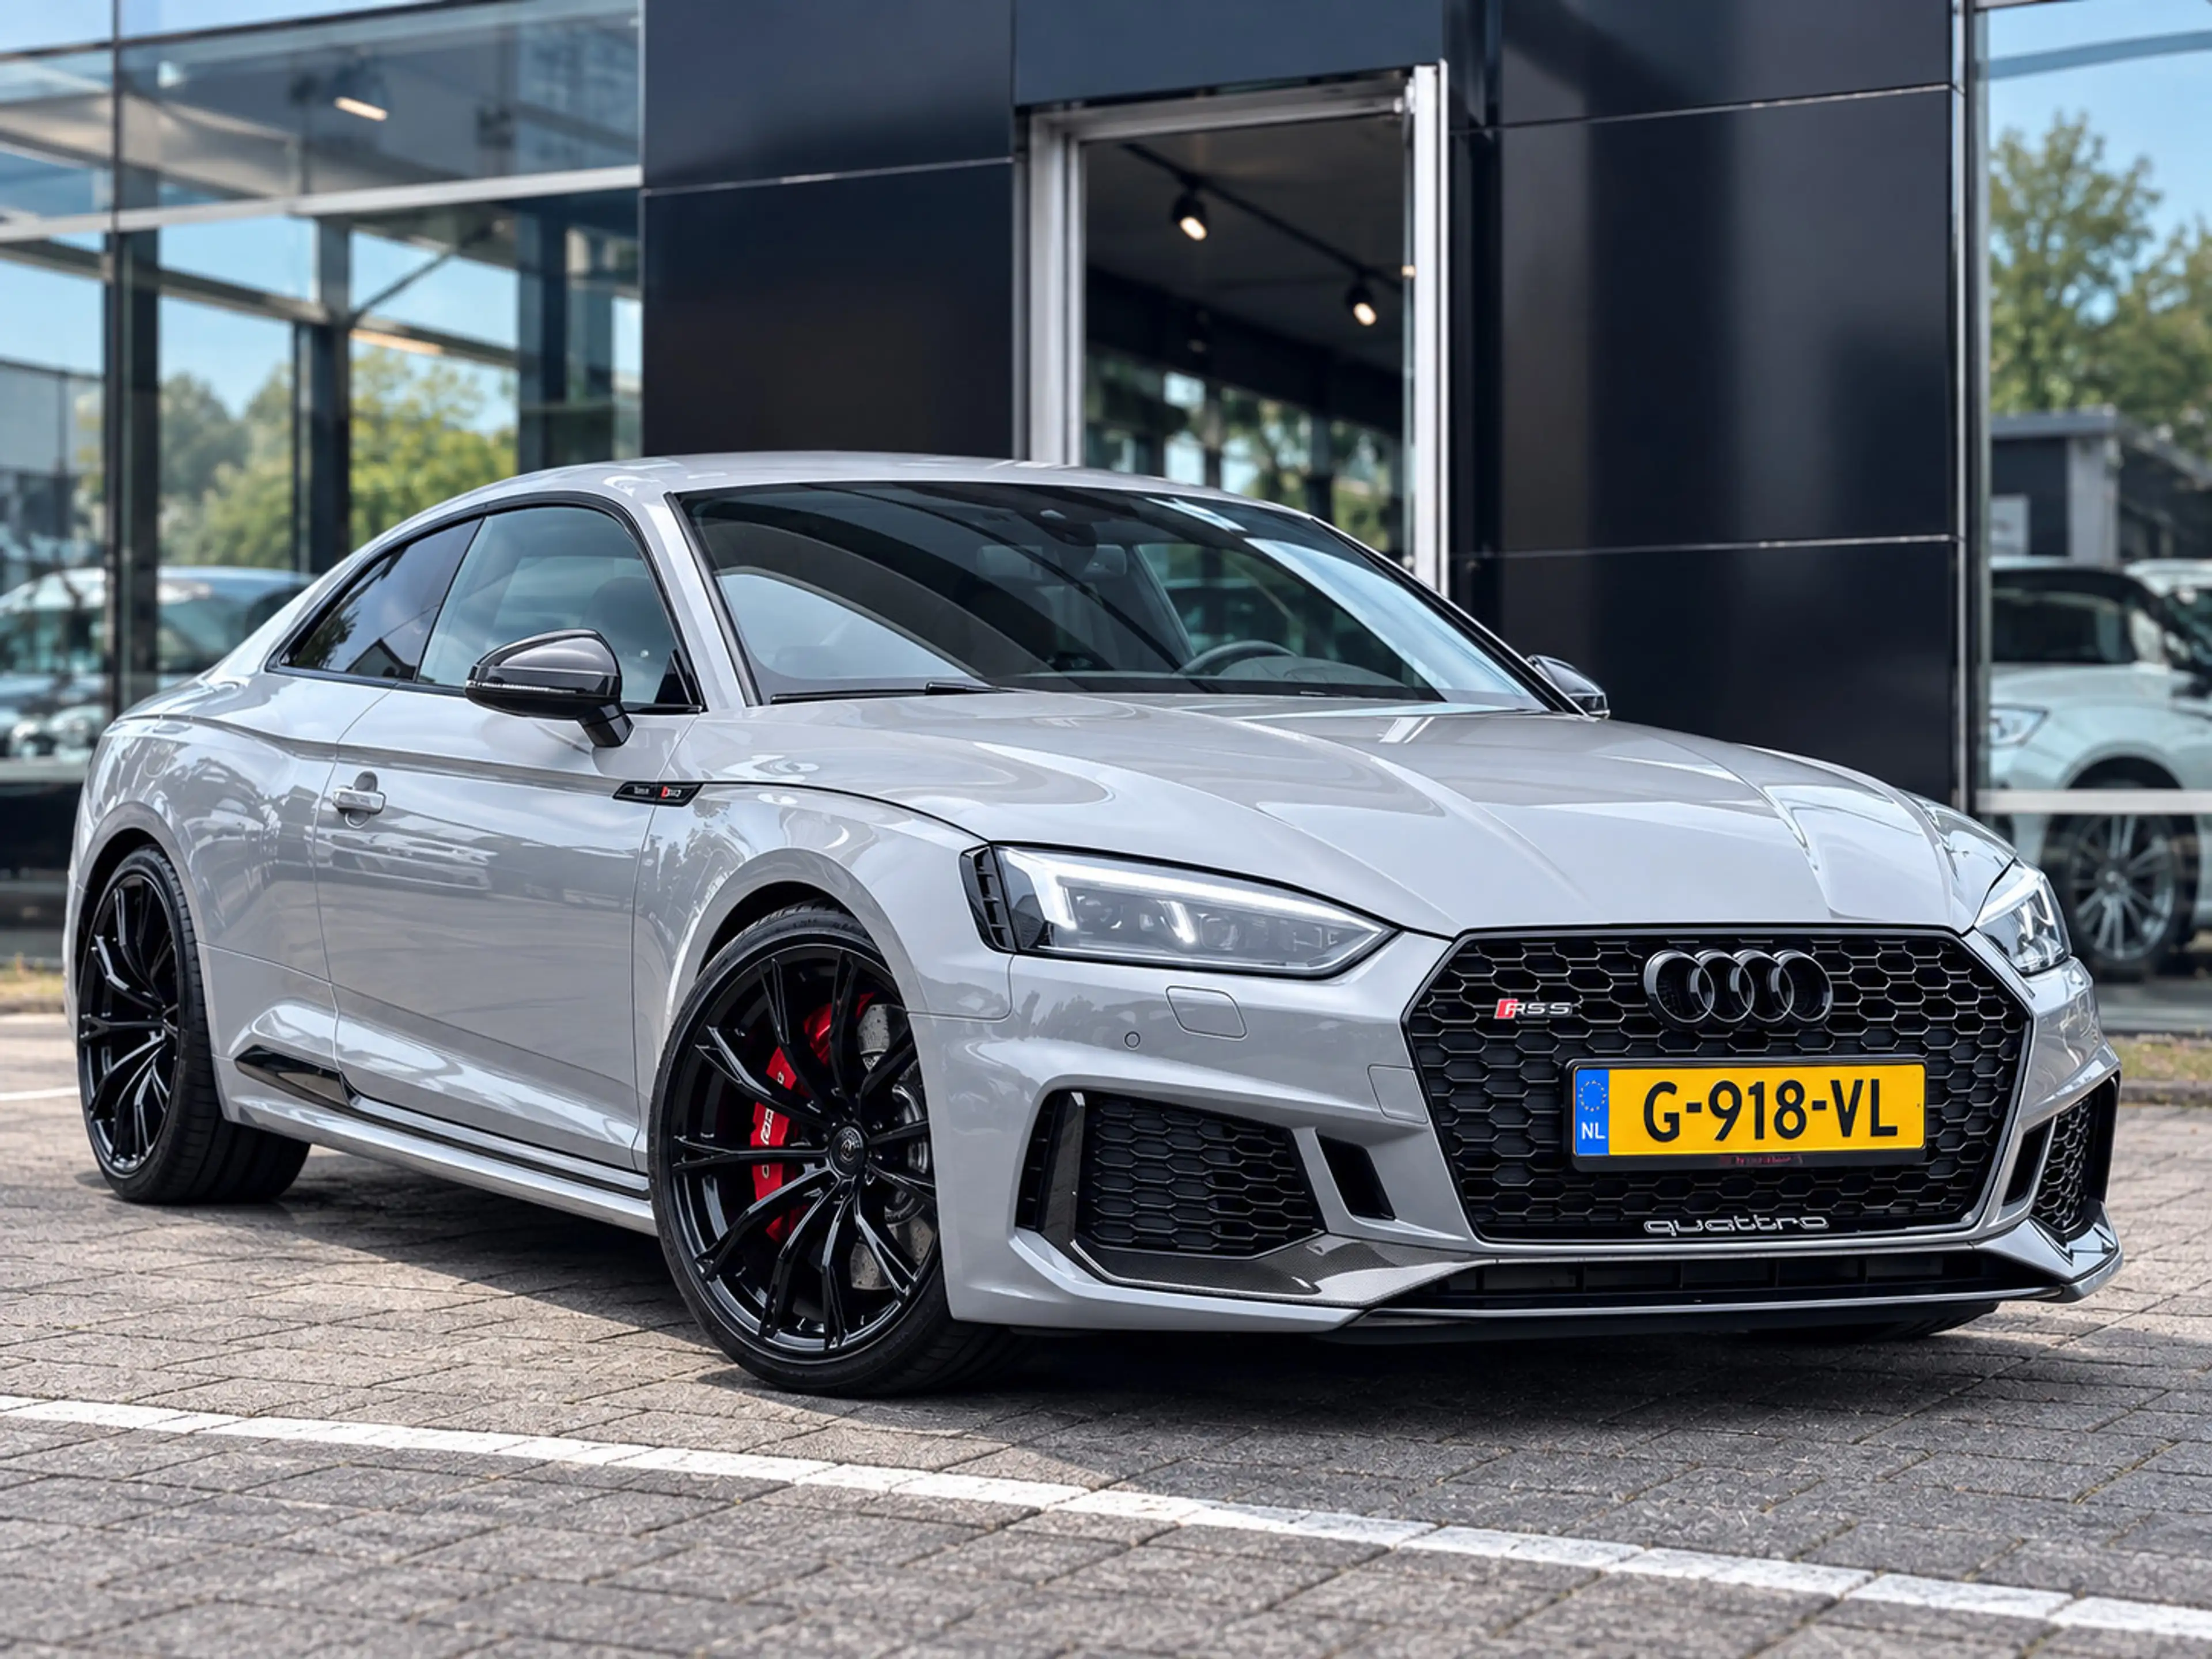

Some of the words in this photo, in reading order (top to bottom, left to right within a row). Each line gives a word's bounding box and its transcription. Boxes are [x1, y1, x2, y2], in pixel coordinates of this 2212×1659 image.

[1643, 1078, 1898, 1142] G-918-VL
[1581, 1122, 1606, 1140] NL
[1643, 1214, 1830, 1237] quattro
